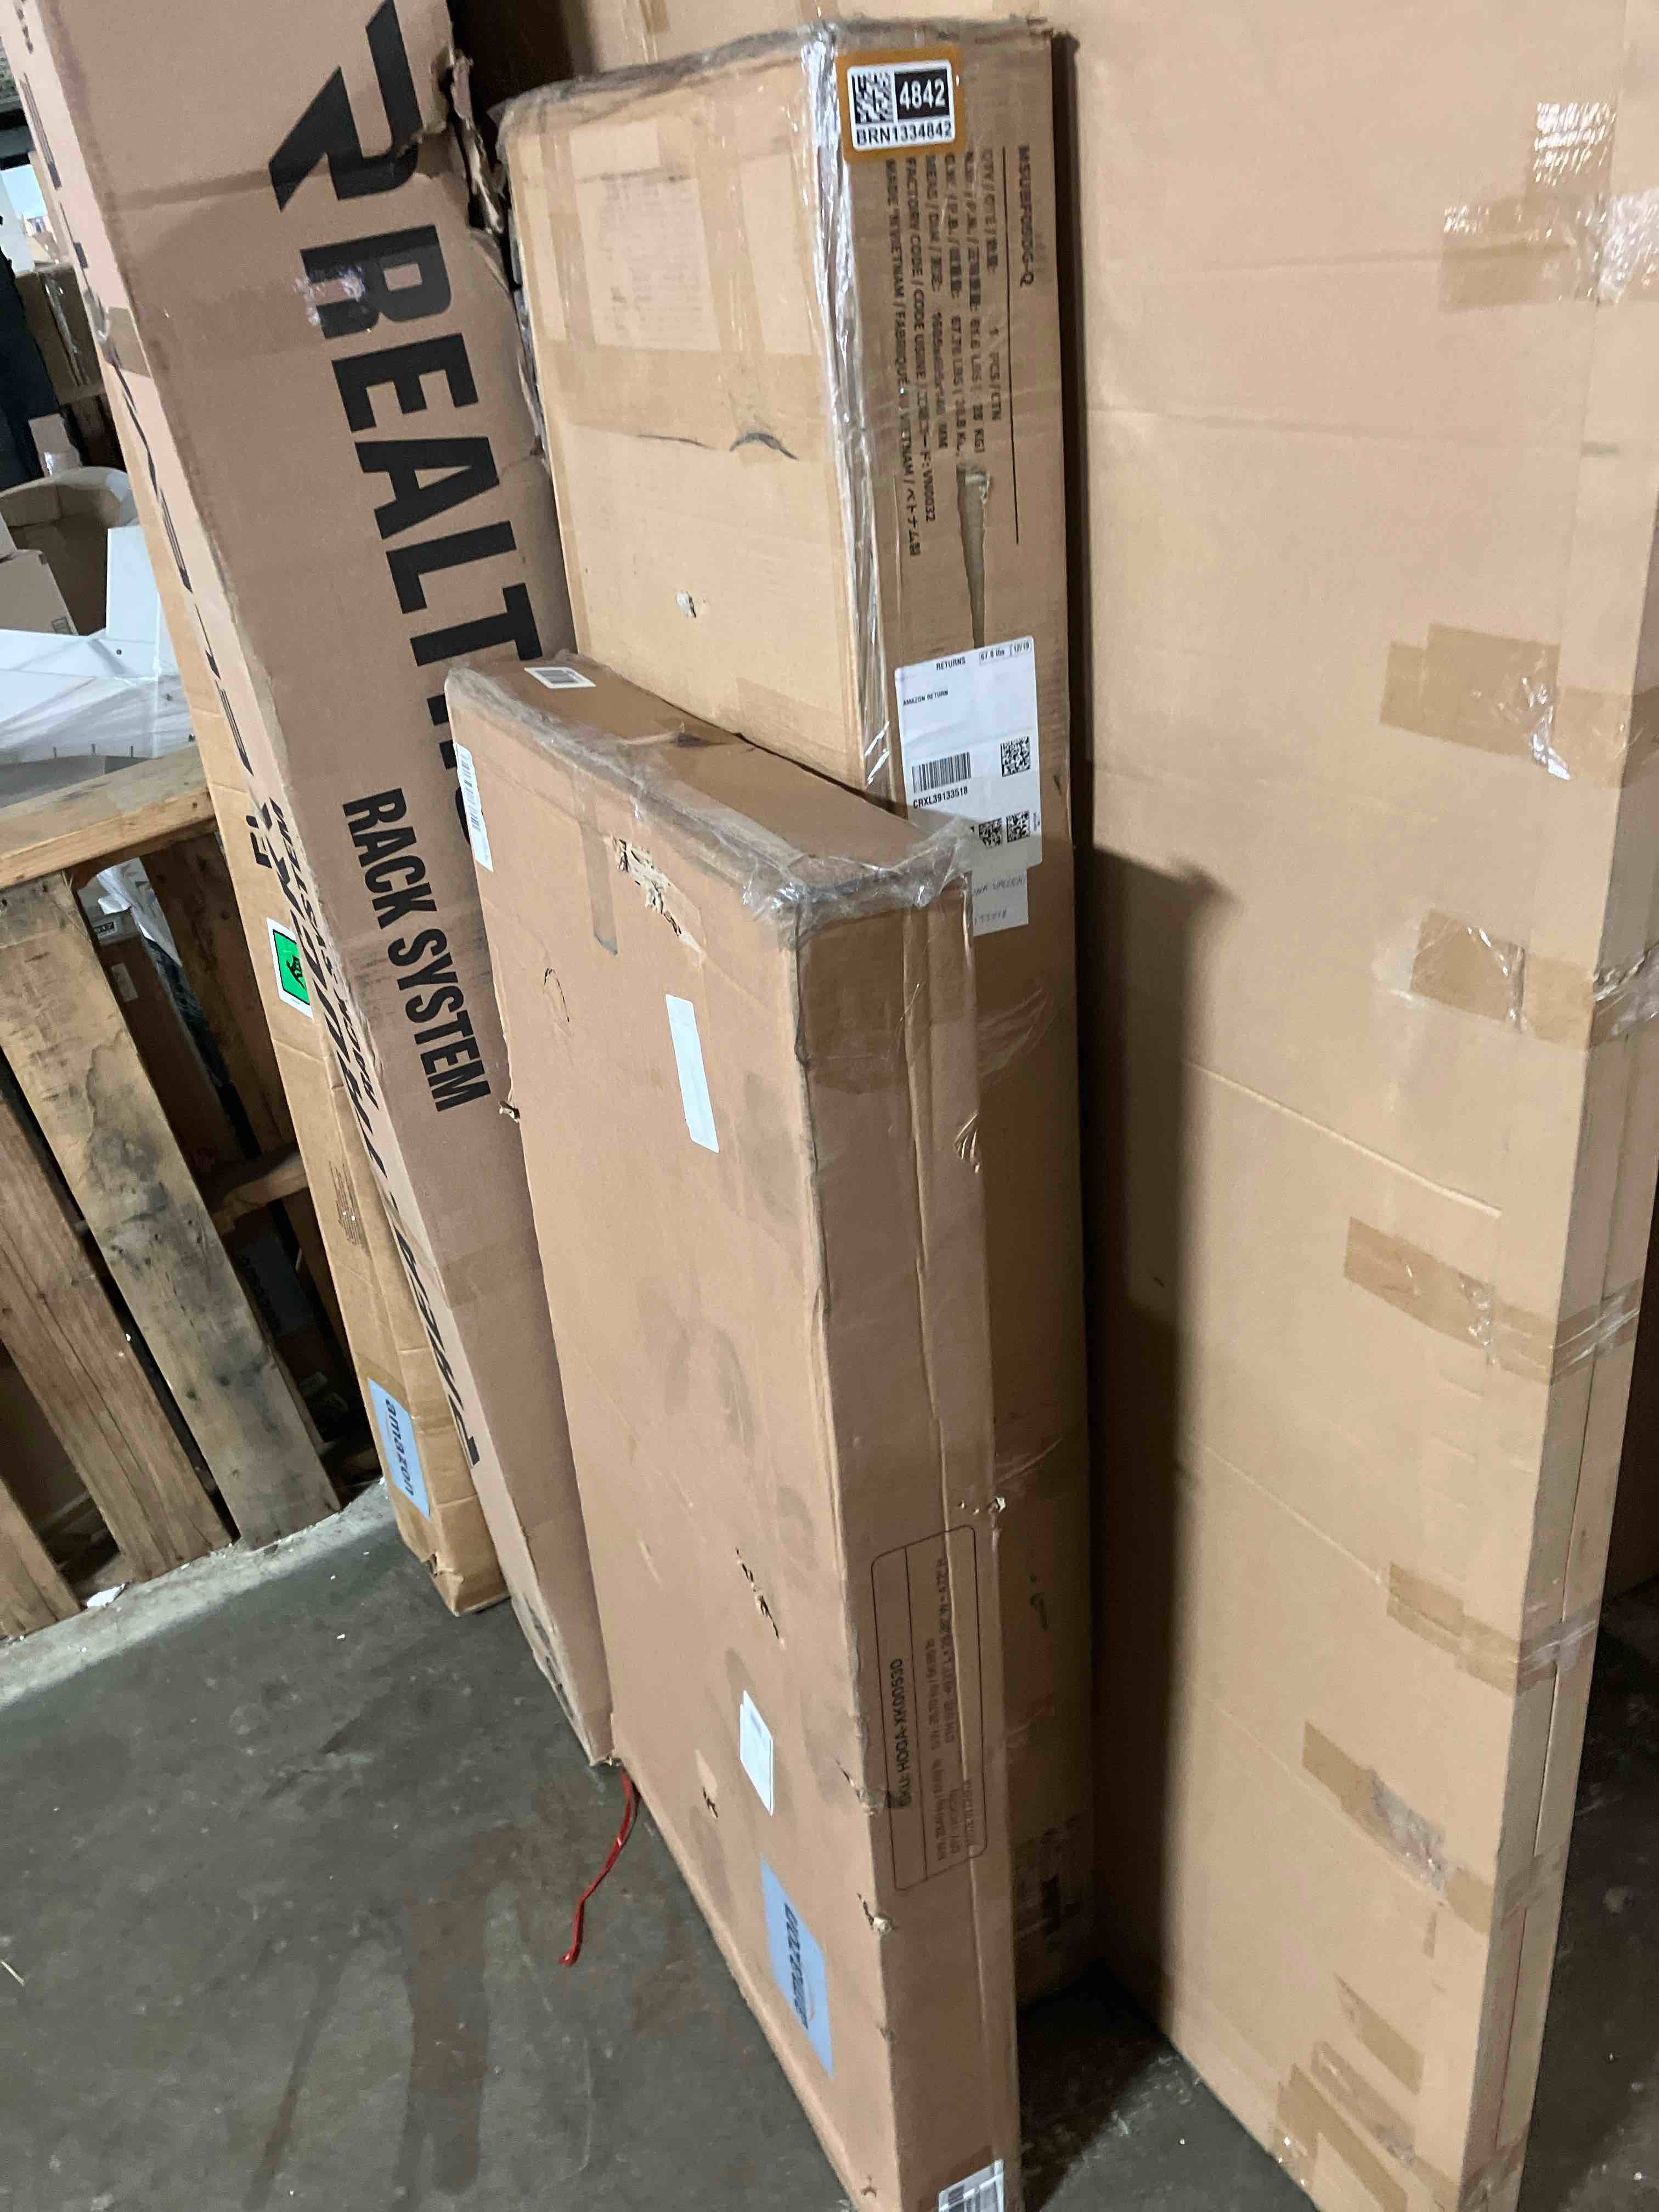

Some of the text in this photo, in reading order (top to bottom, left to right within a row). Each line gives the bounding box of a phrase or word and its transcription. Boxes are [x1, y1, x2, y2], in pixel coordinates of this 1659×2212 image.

[900, 77, 946, 111] 4842
[856, 120, 952, 146] BRN1334842
[913, 287, 925, 331] CODE
[936, 656, 966, 672] RETURNS
[902, 690, 949, 706] AMAZON RETURN
[913, 785, 968, 809] CRXL39133518
[342, 787, 492, 1113] RACK SYSTEM
[385, 1397, 415, 1497] amazon
